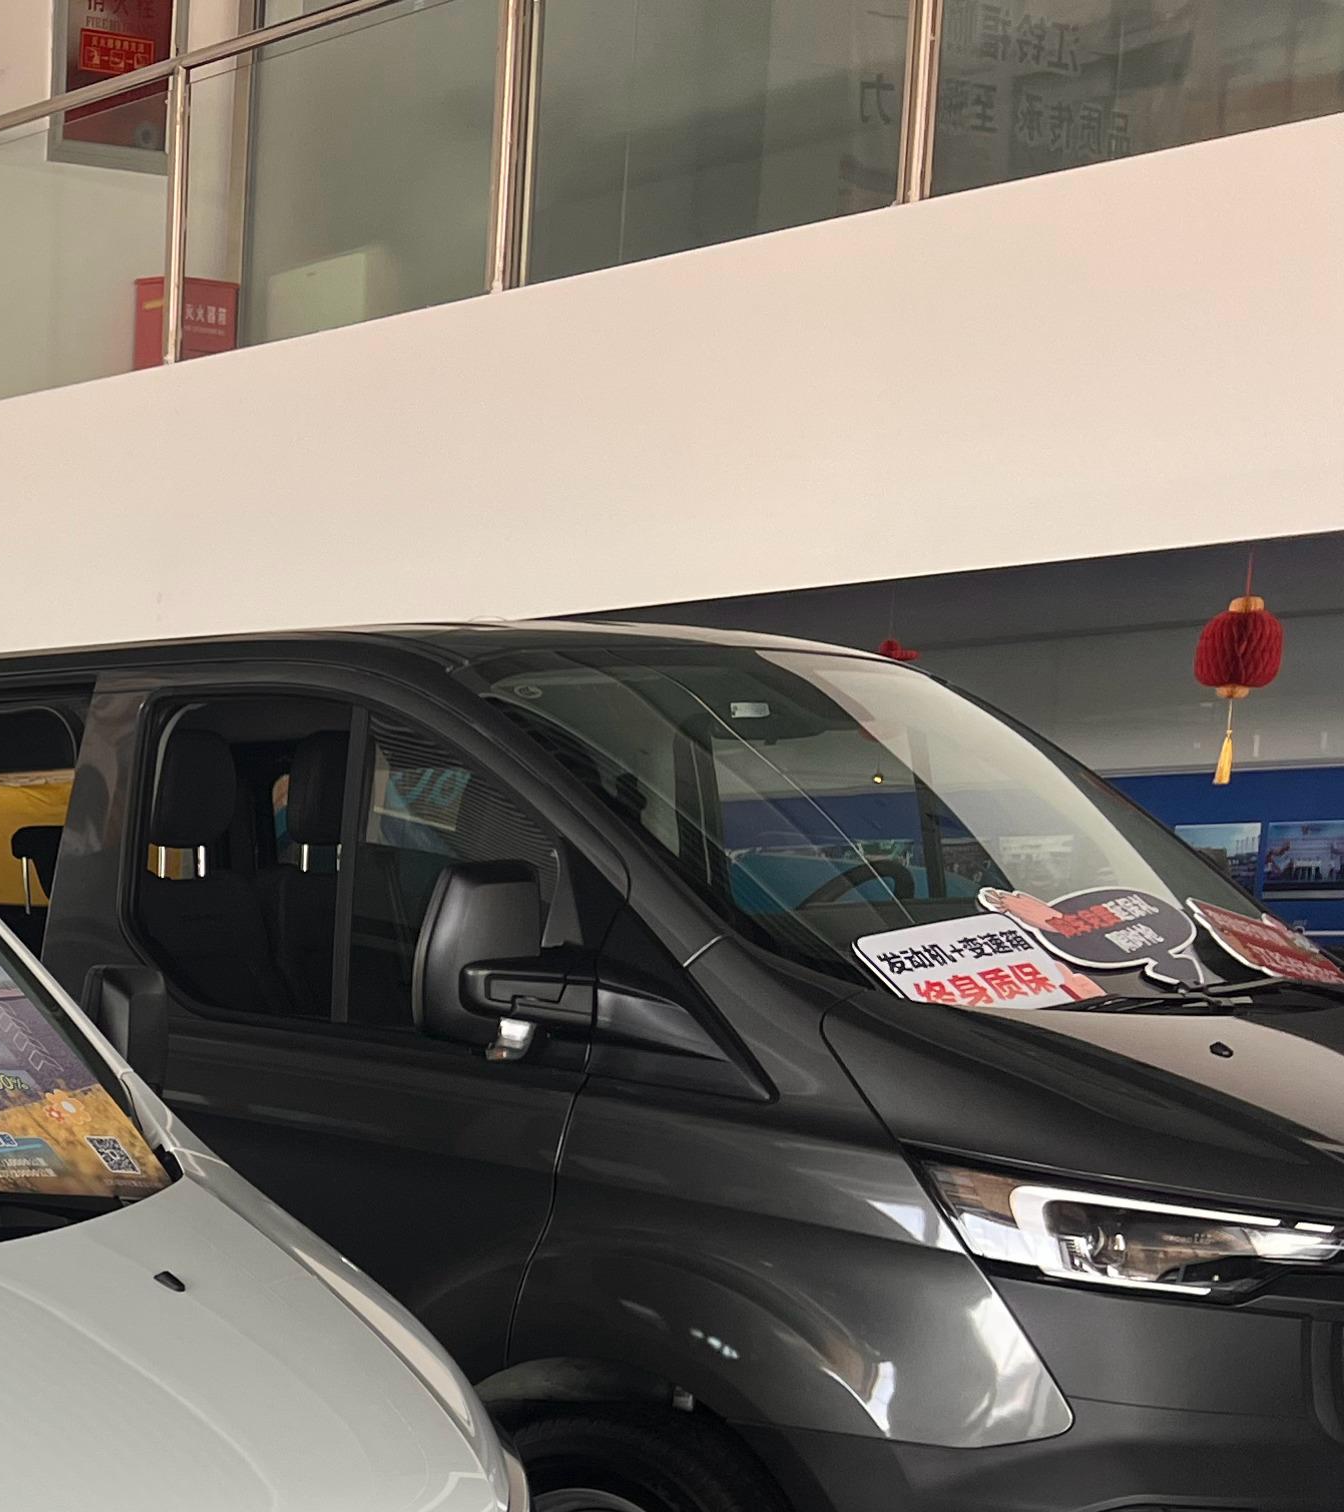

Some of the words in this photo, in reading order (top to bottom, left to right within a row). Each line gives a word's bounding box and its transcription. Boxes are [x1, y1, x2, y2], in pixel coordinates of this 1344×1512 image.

[876, 929, 1035, 975] 发动机+变速箱
[913, 961, 1057, 1007] 终身质保
